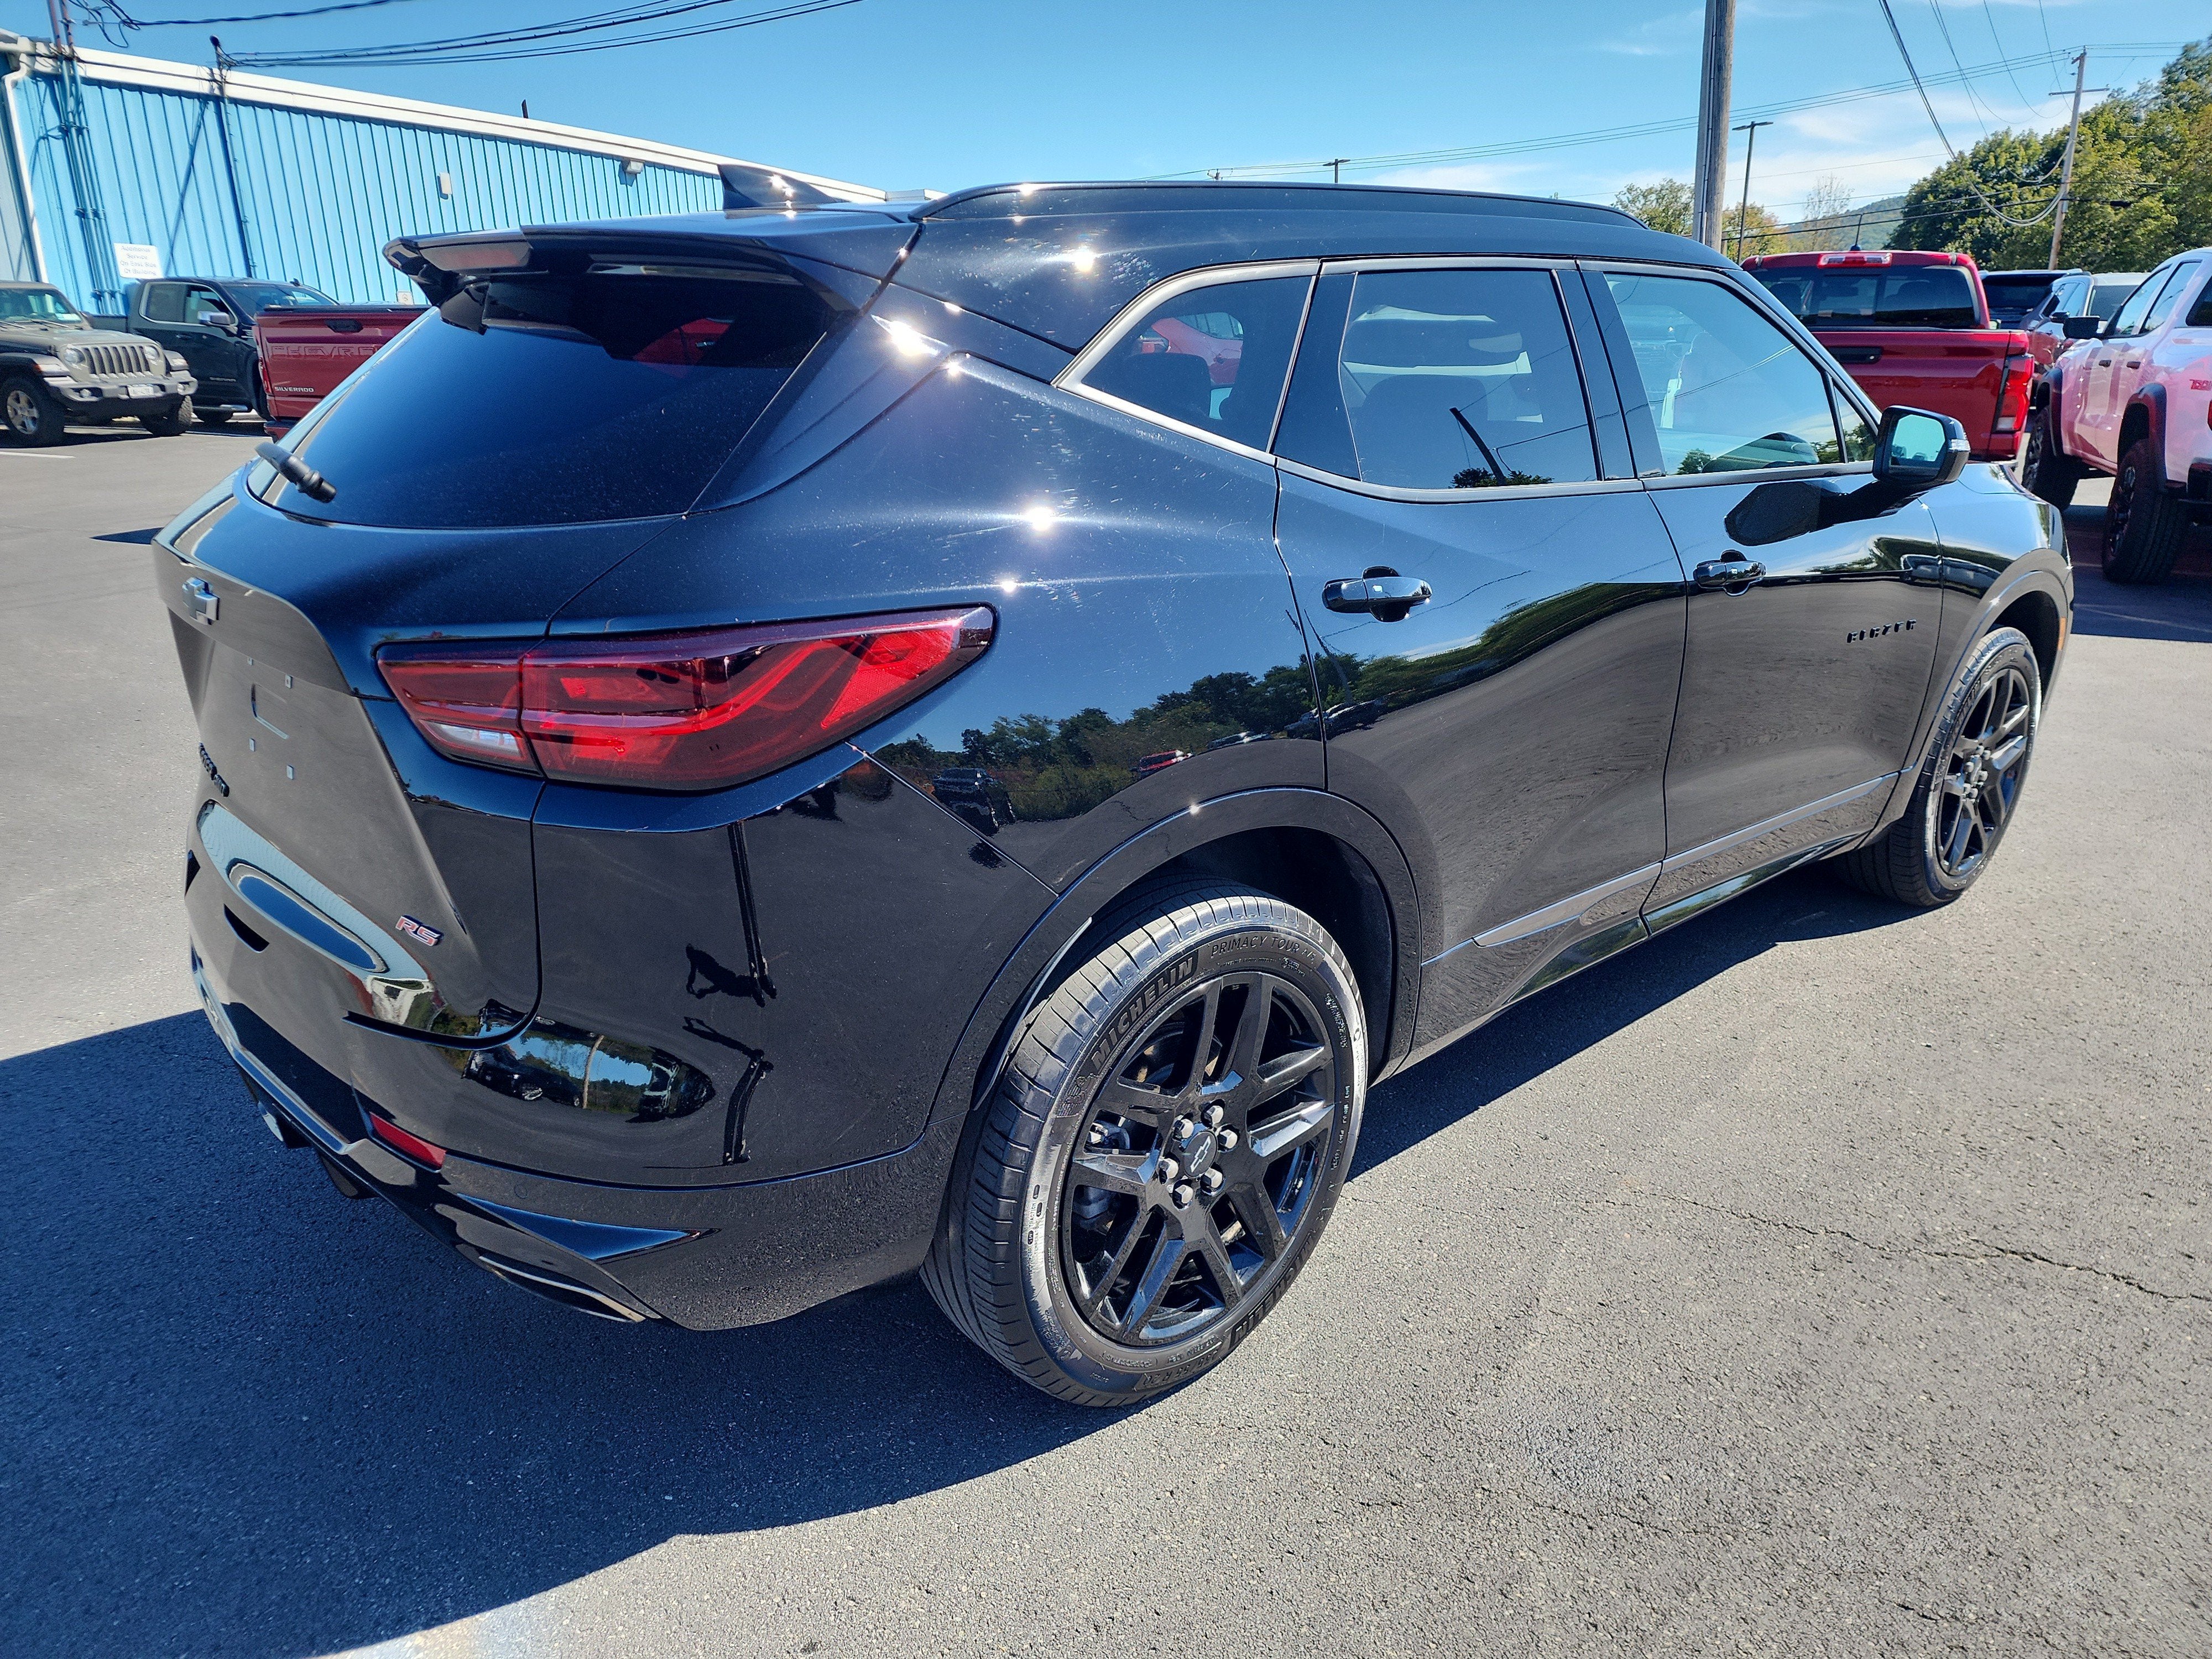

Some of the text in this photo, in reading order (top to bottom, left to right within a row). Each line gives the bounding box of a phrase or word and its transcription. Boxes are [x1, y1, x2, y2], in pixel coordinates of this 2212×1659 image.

[395, 915, 442, 946] RS
[1211, 936, 1267, 958] PRIMACY
[1271, 937, 1300, 953] TOUR
[1091, 957, 1193, 1071] MICHELIN
